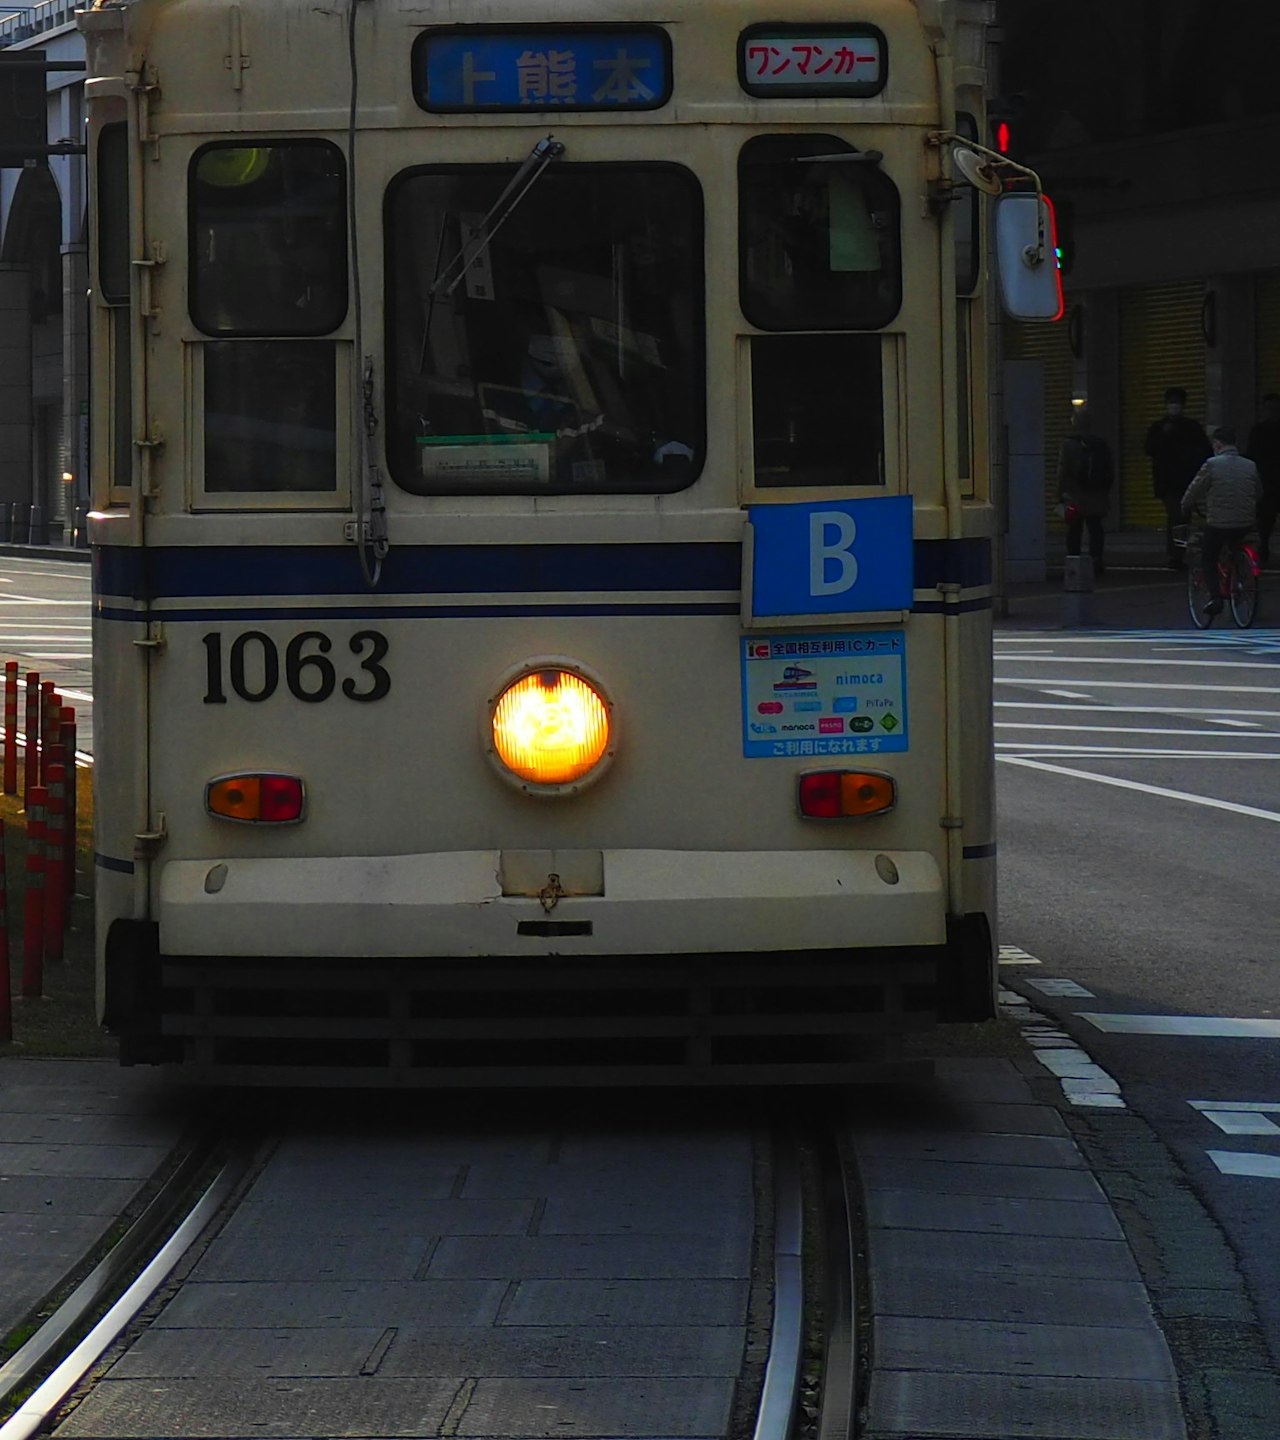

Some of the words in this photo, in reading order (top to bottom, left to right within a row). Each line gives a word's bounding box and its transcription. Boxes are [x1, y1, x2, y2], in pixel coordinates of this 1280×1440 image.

[748, 45, 876, 76] ワンマンカー
[810, 511, 858, 596] B
[773, 639, 900, 655] 全国相互利用ICカード
[202, 631, 392, 703] 1063
[836, 672, 883, 685] nimoca
[866, 699, 893, 707] PiTaPa
[773, 738, 882, 755] ご利用になれます
